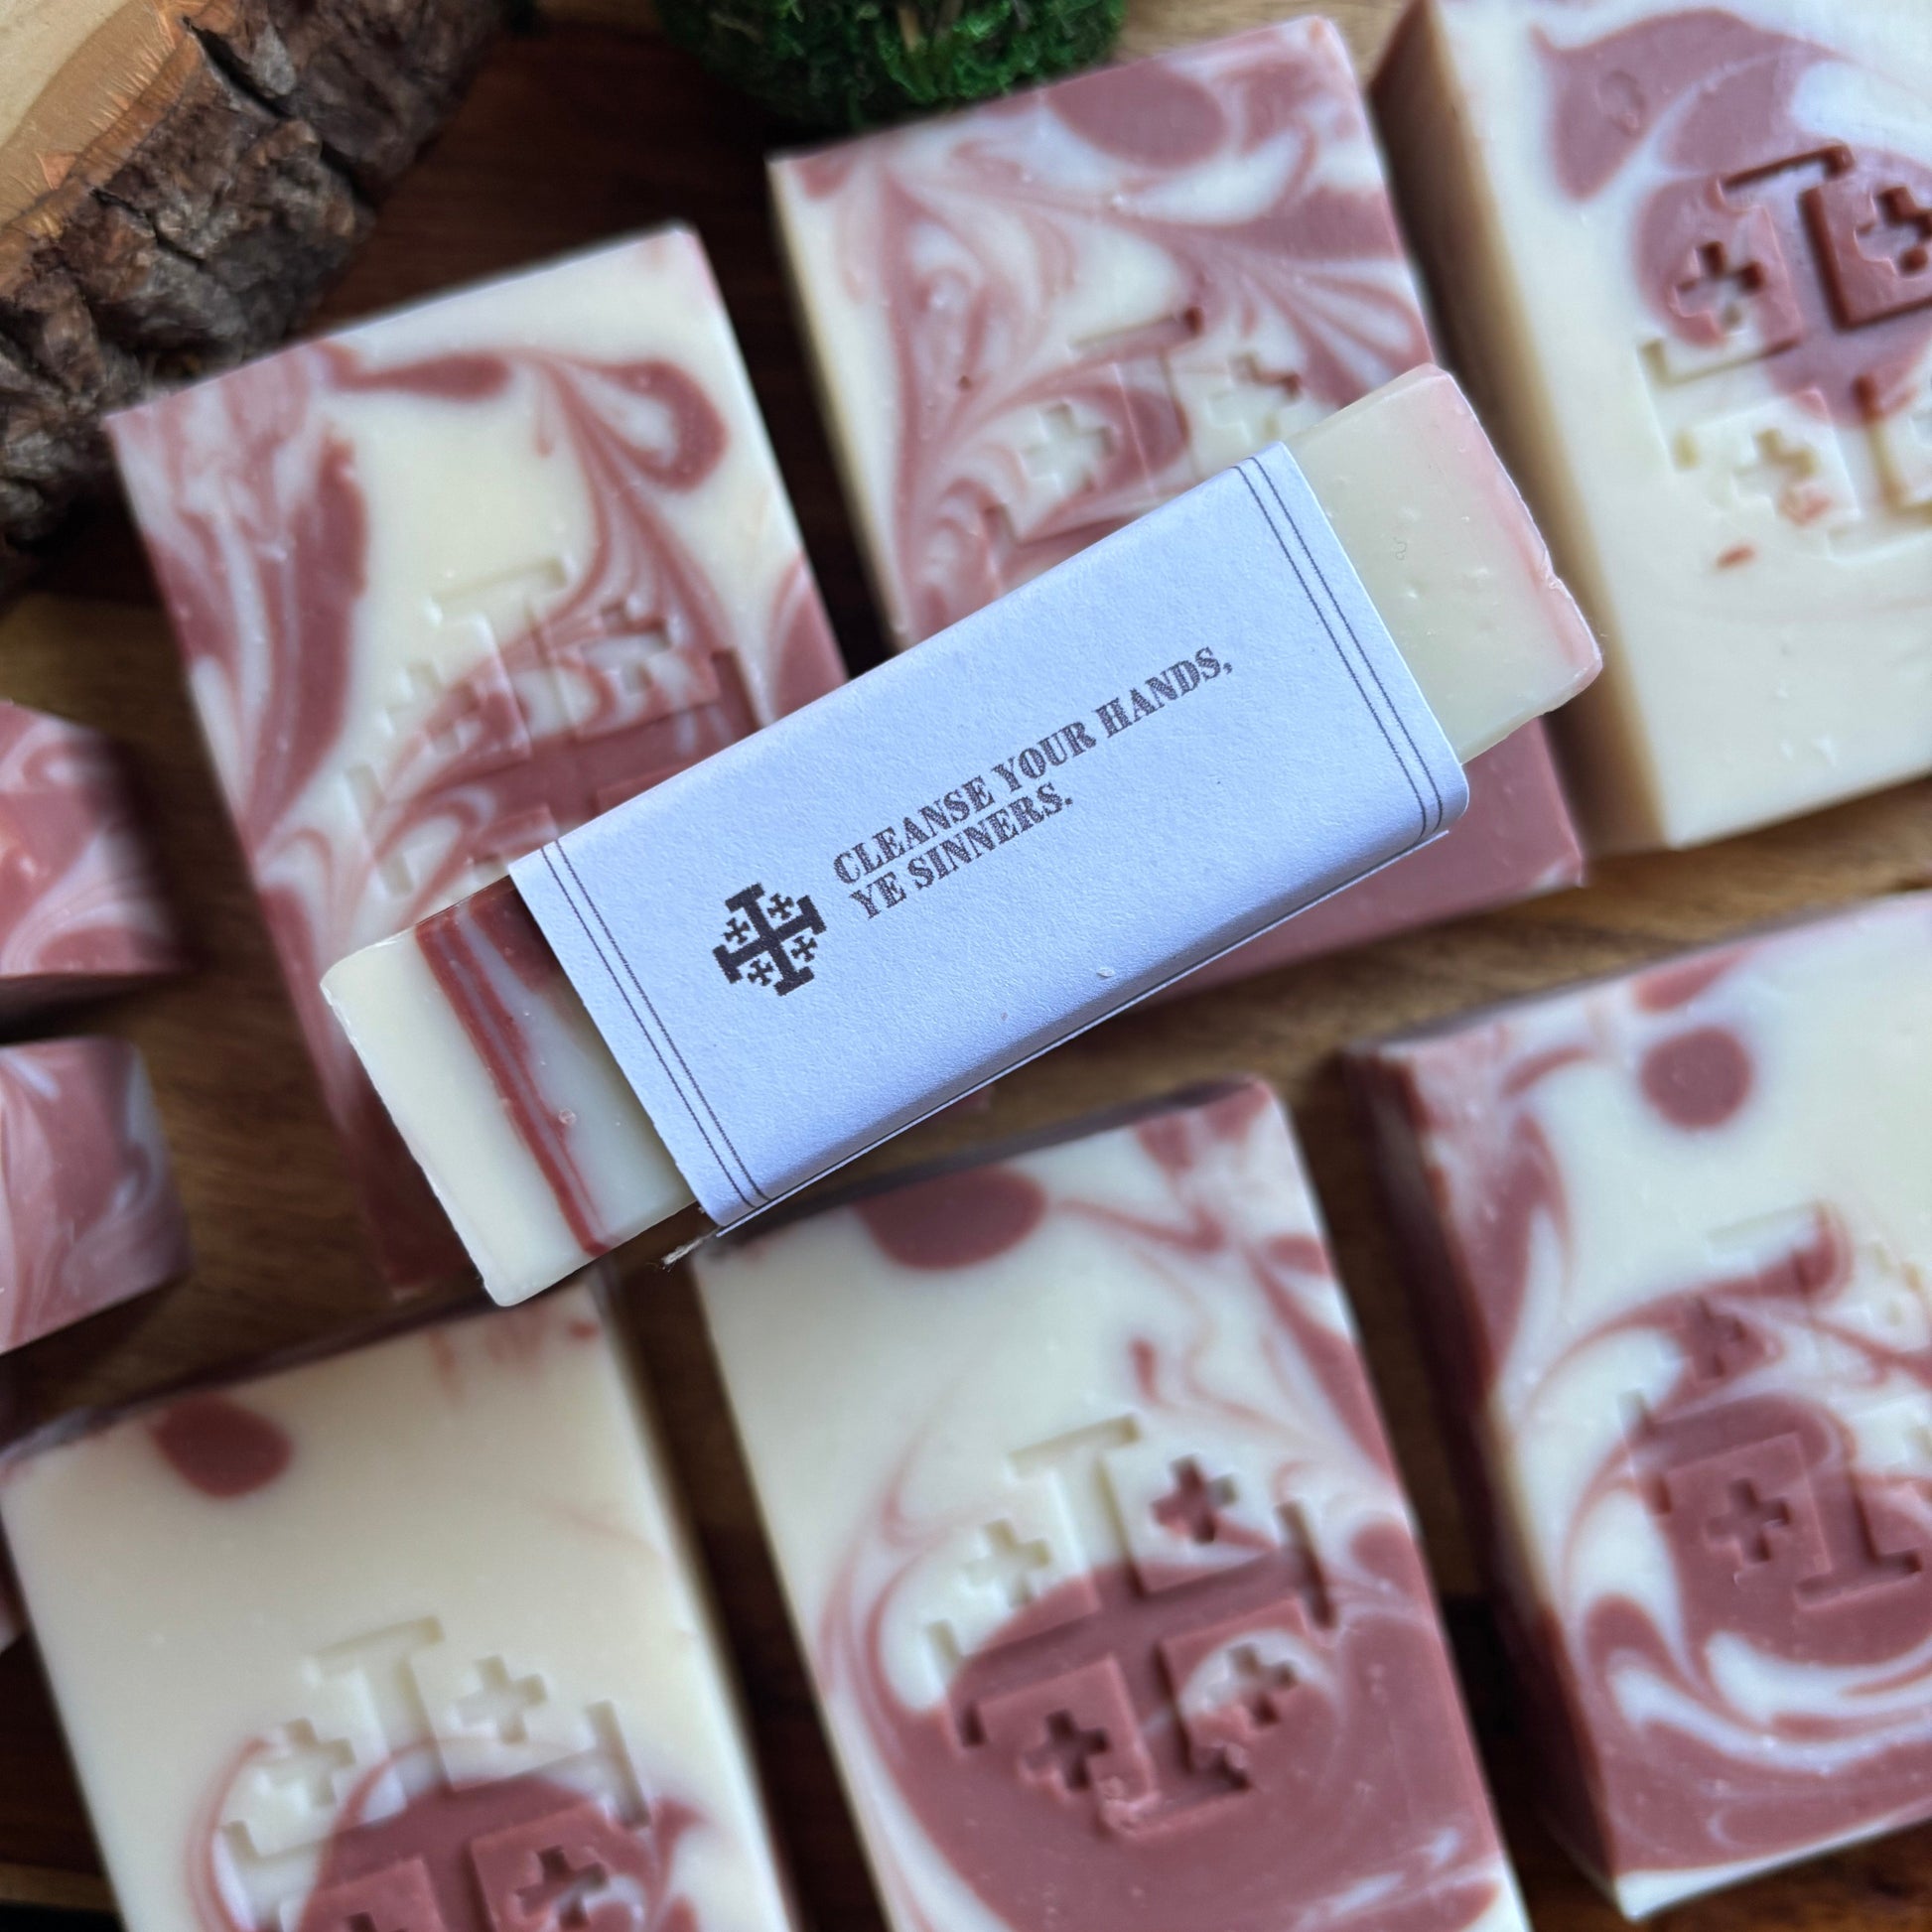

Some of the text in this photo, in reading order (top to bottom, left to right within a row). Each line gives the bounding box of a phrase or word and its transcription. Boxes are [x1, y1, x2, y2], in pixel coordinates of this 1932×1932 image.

[832, 646, 1233, 885] CLEANSE YOUR HANDS,
[849, 781, 1073, 919] YE SINNERS.
